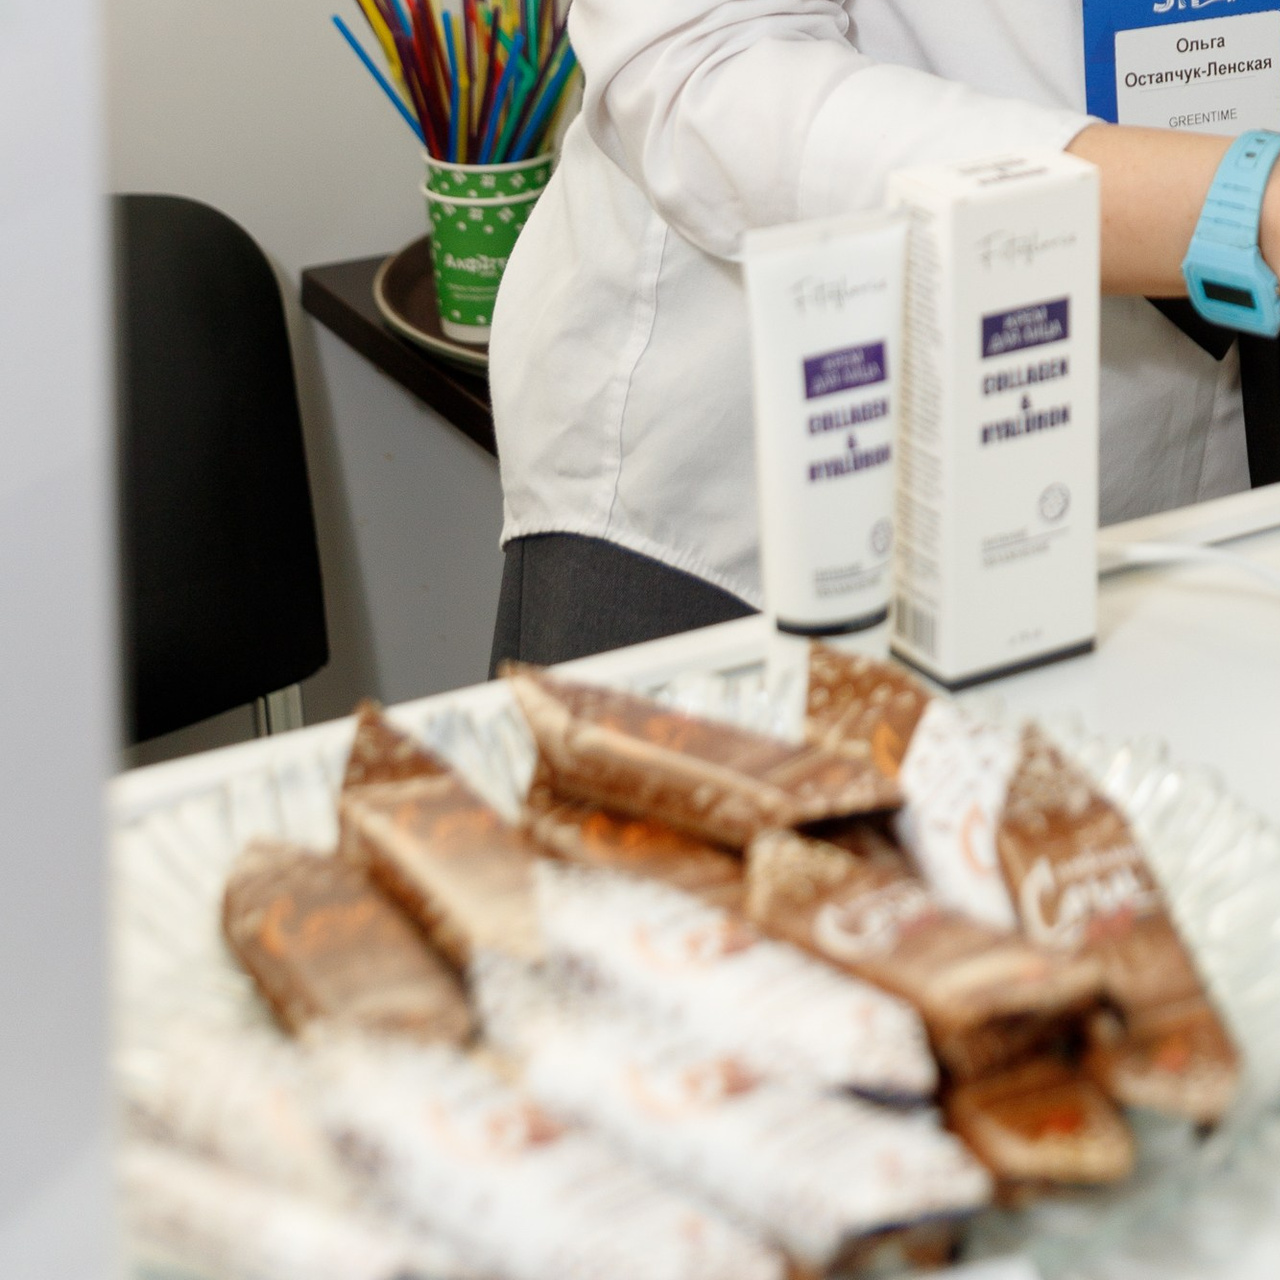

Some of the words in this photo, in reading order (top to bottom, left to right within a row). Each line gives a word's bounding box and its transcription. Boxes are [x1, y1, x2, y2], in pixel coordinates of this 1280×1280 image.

[1176, 36, 1225, 53] Ольга
[1125, 58, 1272, 87] Остапчук-Ленская
[1169, 108, 1237, 128] GREENTIME
